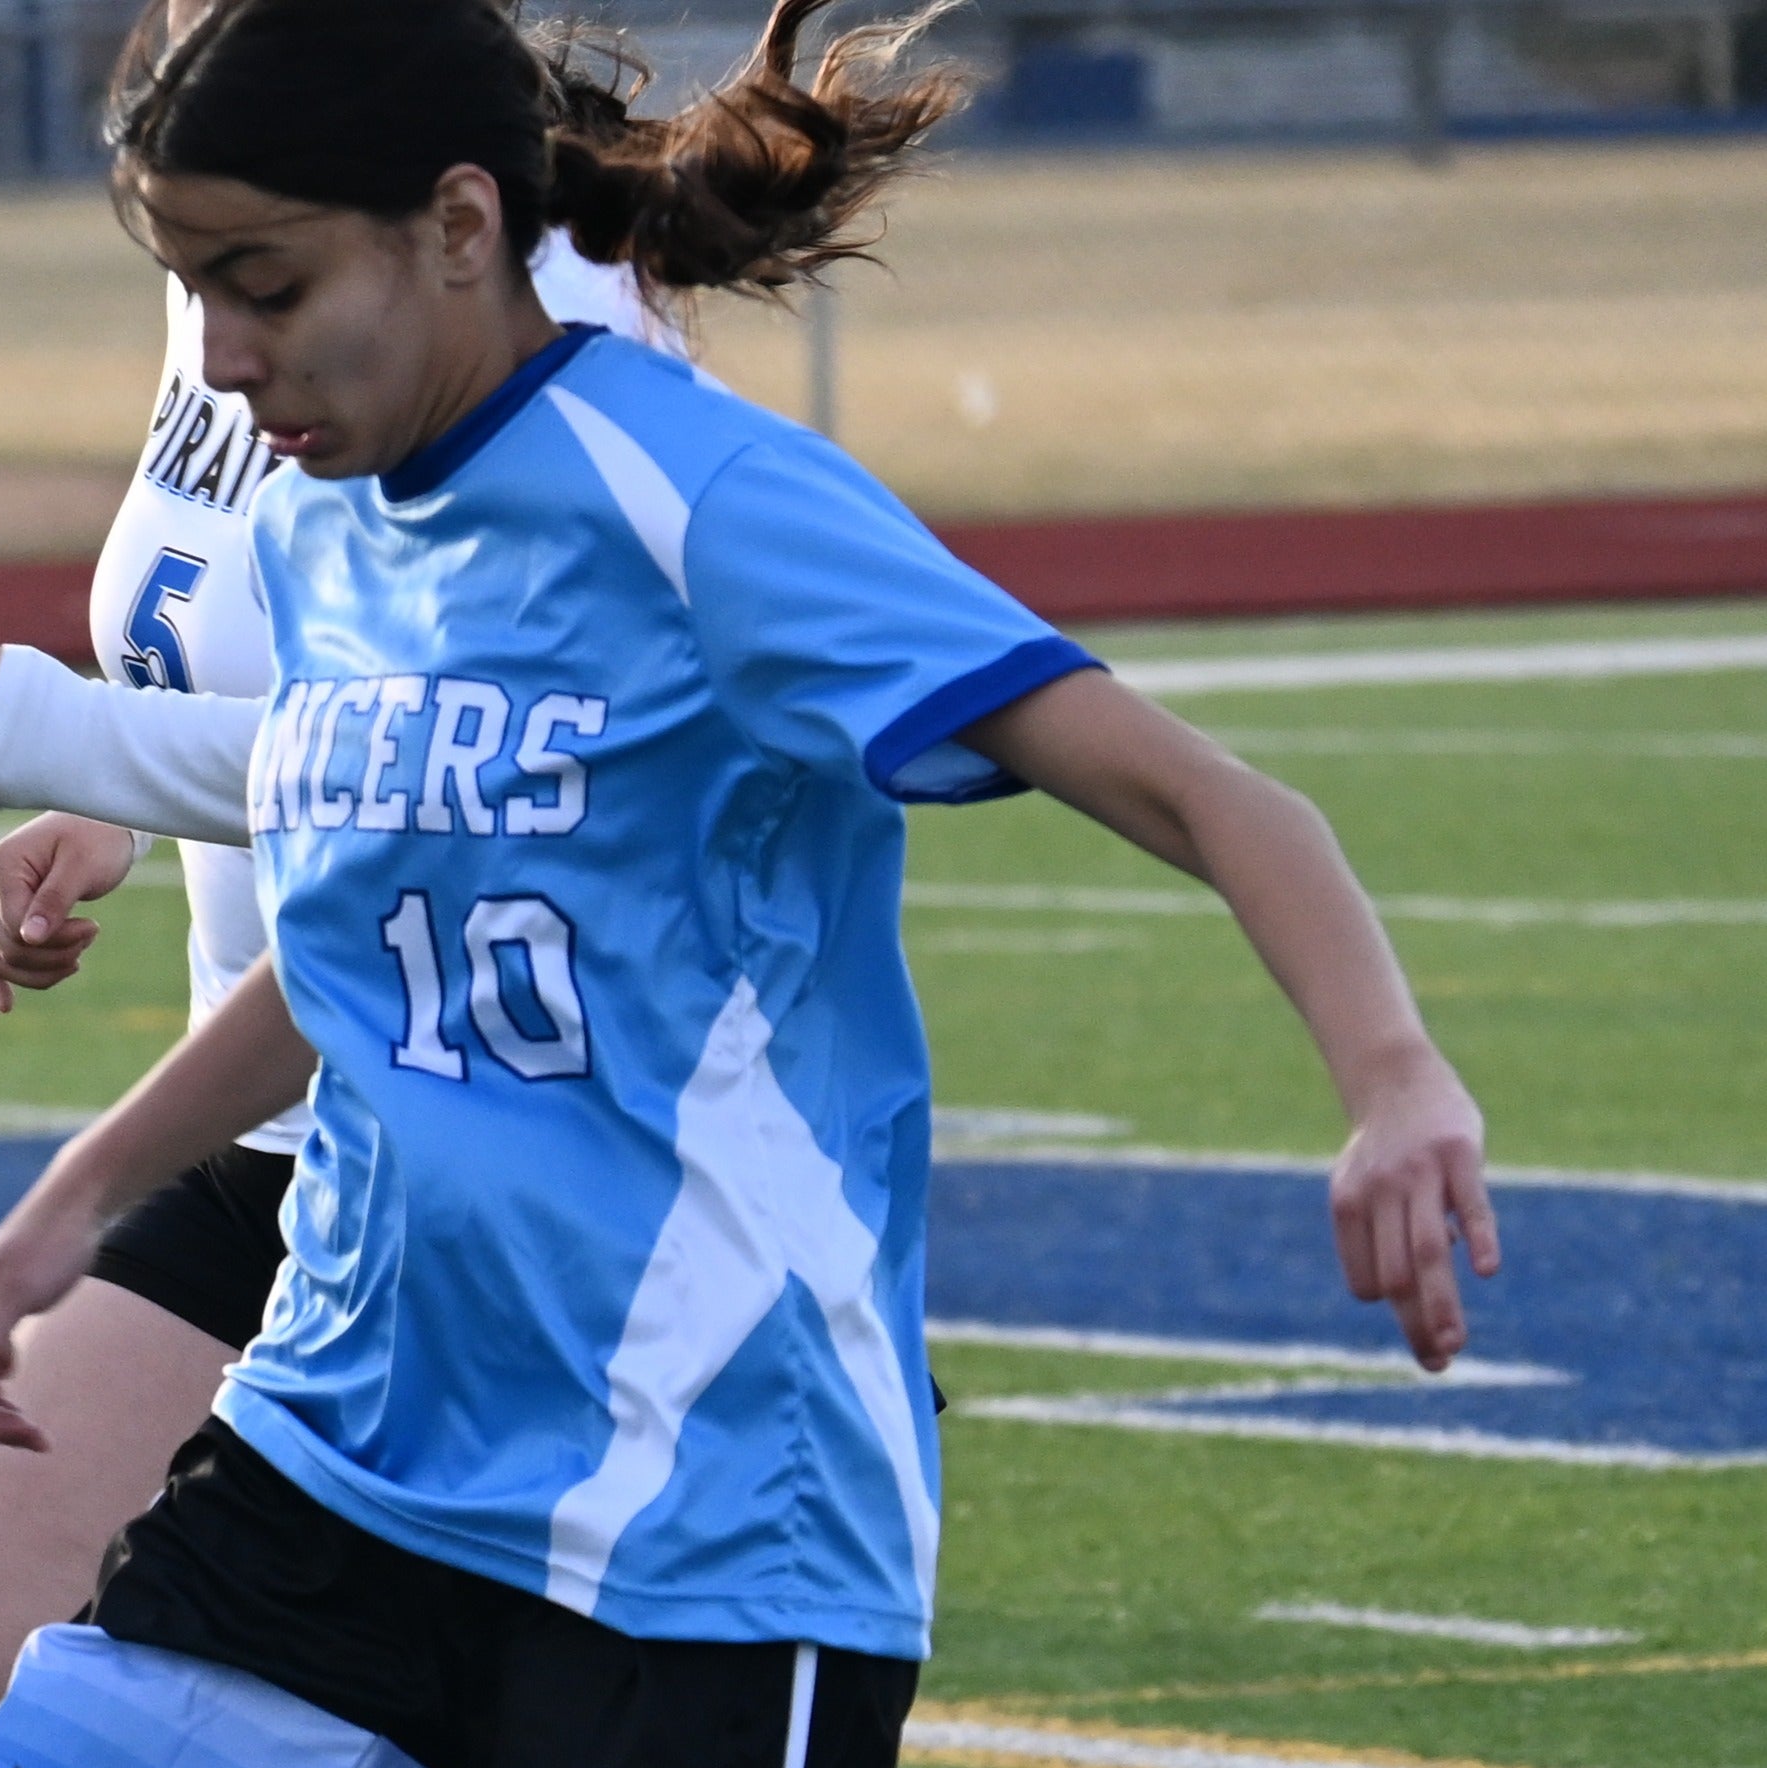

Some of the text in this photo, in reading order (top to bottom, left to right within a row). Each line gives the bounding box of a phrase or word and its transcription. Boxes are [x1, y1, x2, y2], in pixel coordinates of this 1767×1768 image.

[144, 368, 285, 516] PIRAT
[121, 546, 208, 693] 5
[248, 673, 609, 837] NCERS
[380, 889, 590, 1081] 10
